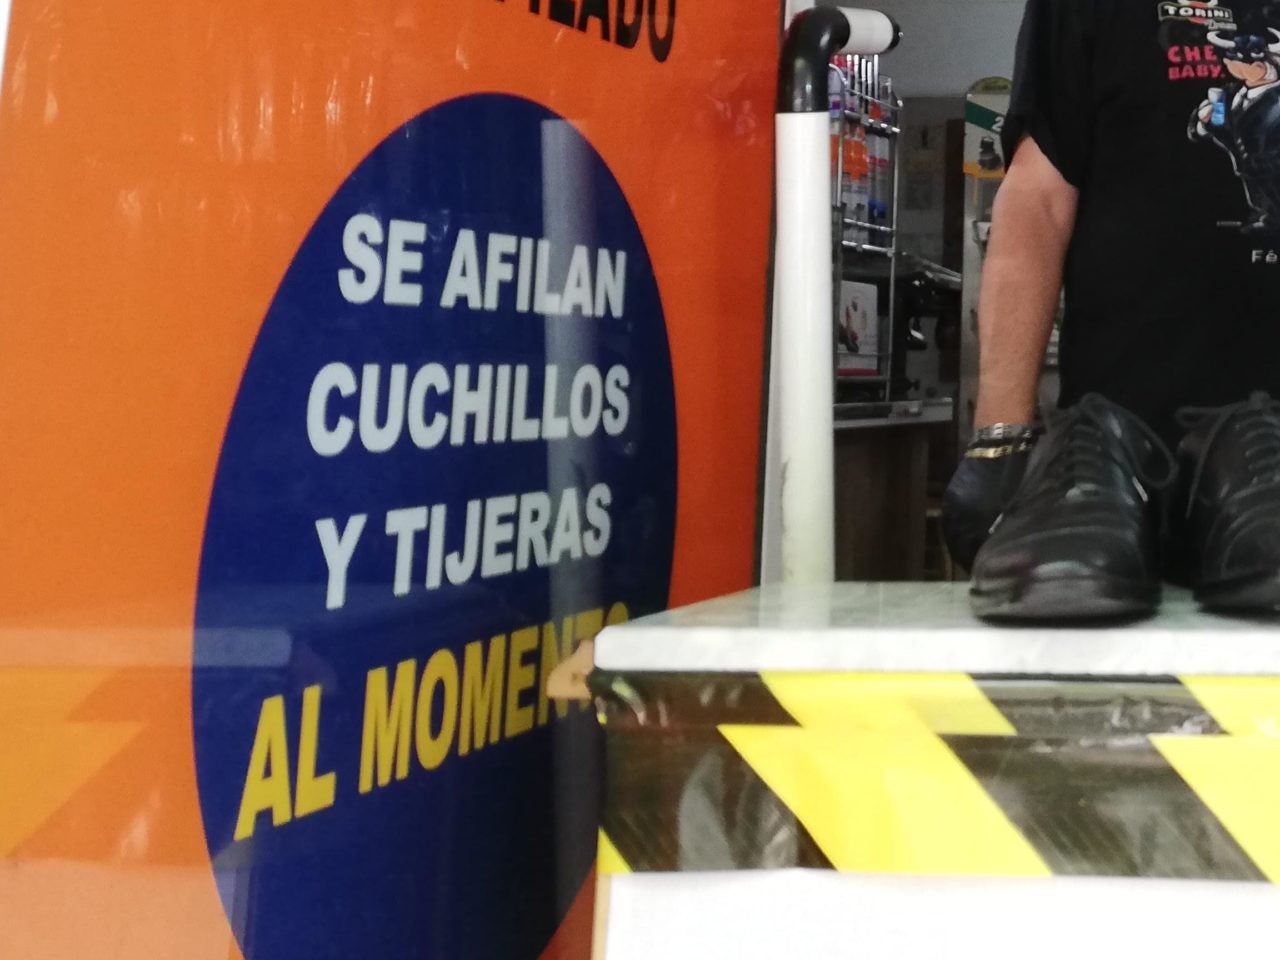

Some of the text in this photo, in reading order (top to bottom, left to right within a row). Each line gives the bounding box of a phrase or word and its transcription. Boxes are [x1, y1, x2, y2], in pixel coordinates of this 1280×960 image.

[1163, 5, 1229, 18] TORINI
[1167, 44, 1217, 63] CHE
[337, 213, 628, 318] SE AFILAN
[306, 361, 630, 458] CUCHILLOS
[315, 483, 612, 610] Y TIJERAS
[233, 684, 337, 842] AL
